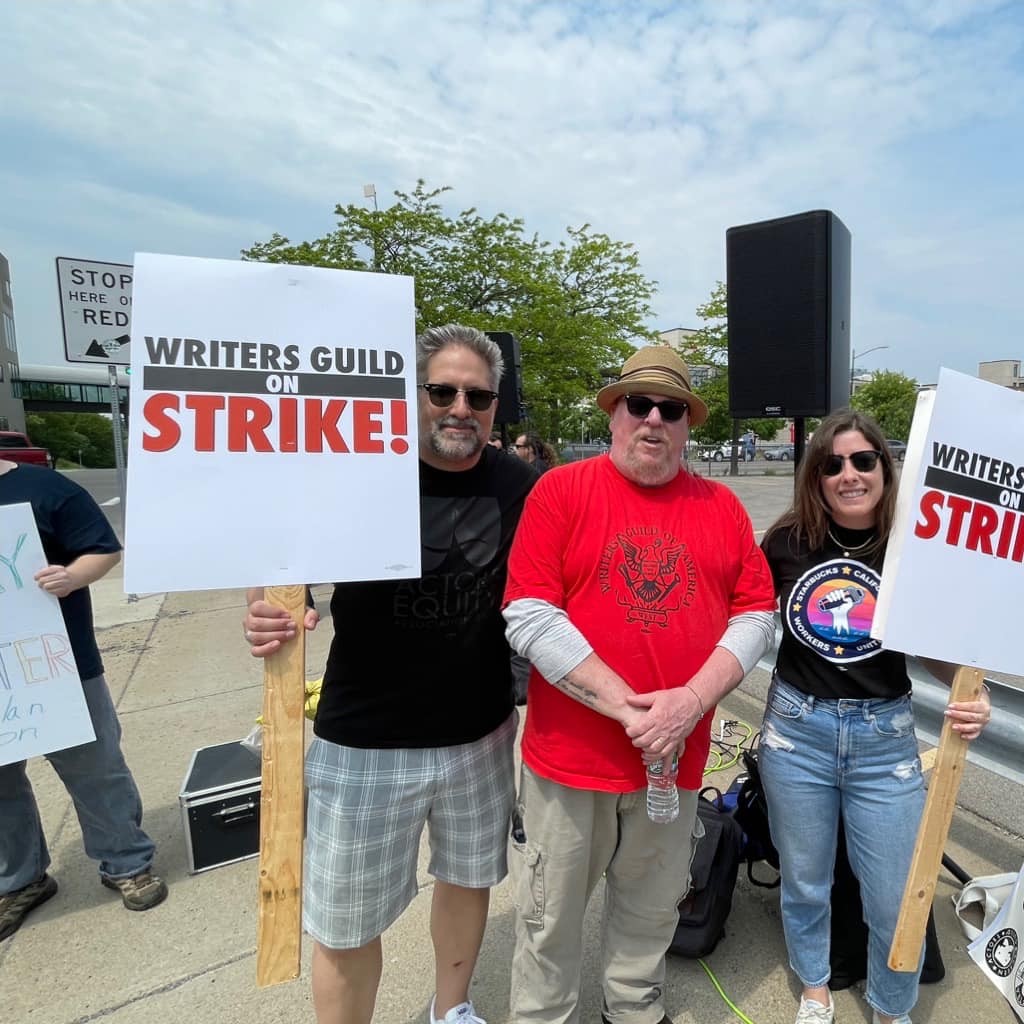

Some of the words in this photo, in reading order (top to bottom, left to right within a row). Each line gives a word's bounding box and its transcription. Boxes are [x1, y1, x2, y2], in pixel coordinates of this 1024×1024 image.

[71, 269, 132, 289] STOP
[69, 291, 107, 303] HERE
[120, 296, 132, 306] O
[83, 309, 129, 327] RED
[144, 336, 299, 371] WRITERS
[310, 346, 404, 376] GUILD
[266, 375, 298, 393] ON
[142, 393, 409, 455] STRIKE!
[933, 442, 1024, 489] WRITERS
[1000, 490, 1021, 509] ON
[914, 490, 1024, 563] STRI
[600, 541, 618, 594] WRITERS
[626, 528, 658, 537] GUILD
[664, 533, 678, 545] OF
[682, 554, 696, 607] AMERICA
[797, 568, 838, 601] STARBUCKS
[794, 616, 830, 651] WORKERS
